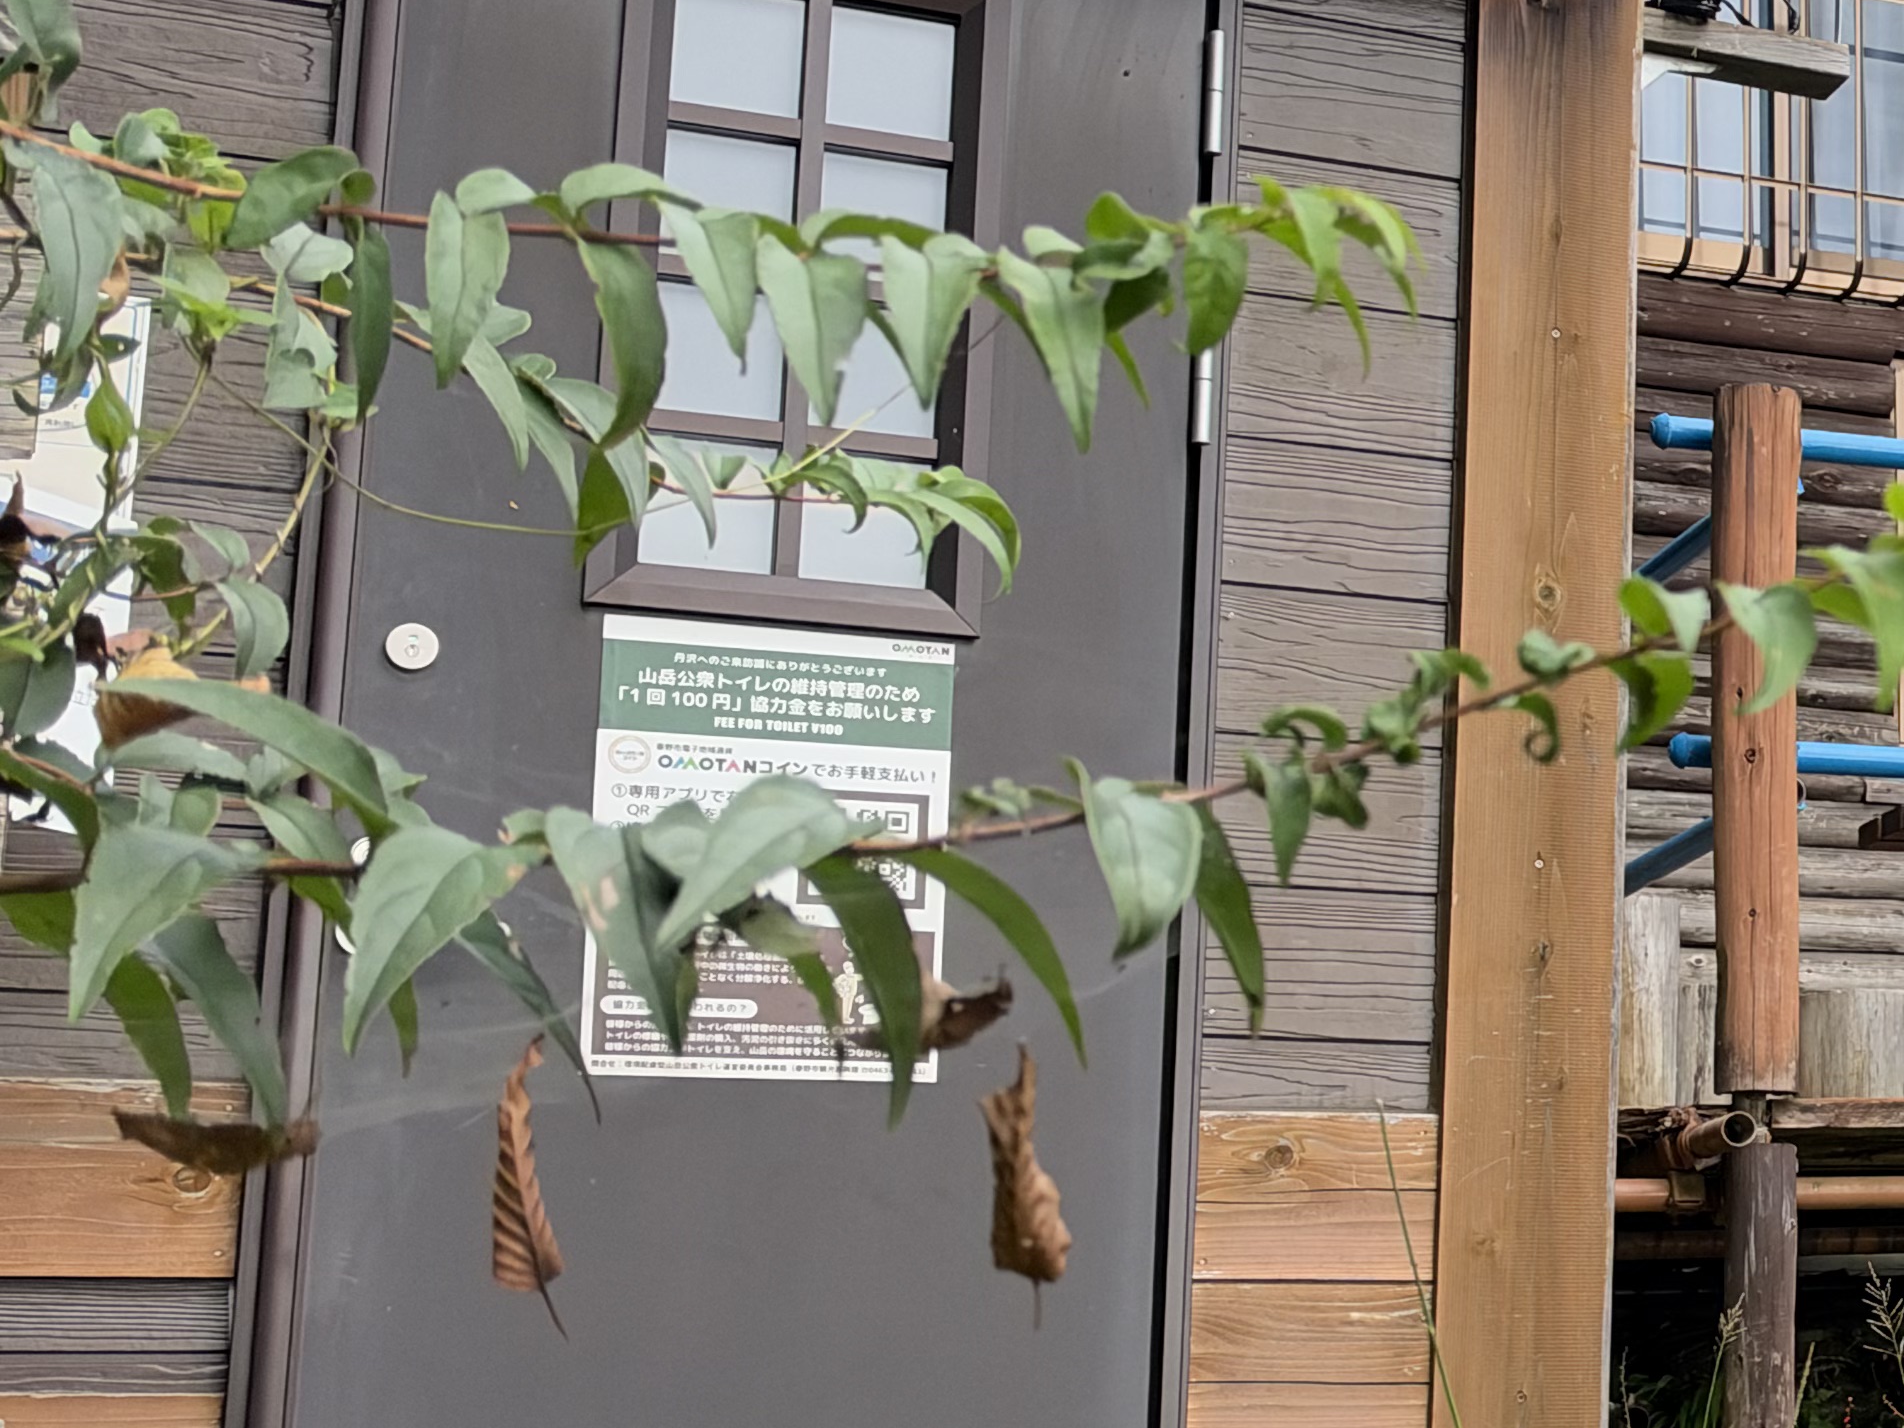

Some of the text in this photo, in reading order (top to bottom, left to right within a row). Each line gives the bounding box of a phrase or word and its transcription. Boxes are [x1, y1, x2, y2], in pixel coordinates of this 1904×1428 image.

[637, 666, 922, 703] 山岳公衆トイレの維持管理のため
[713, 716, 736, 729] FEE
[737, 717, 763, 731] FOR
[766, 719, 808, 733] TOILET
